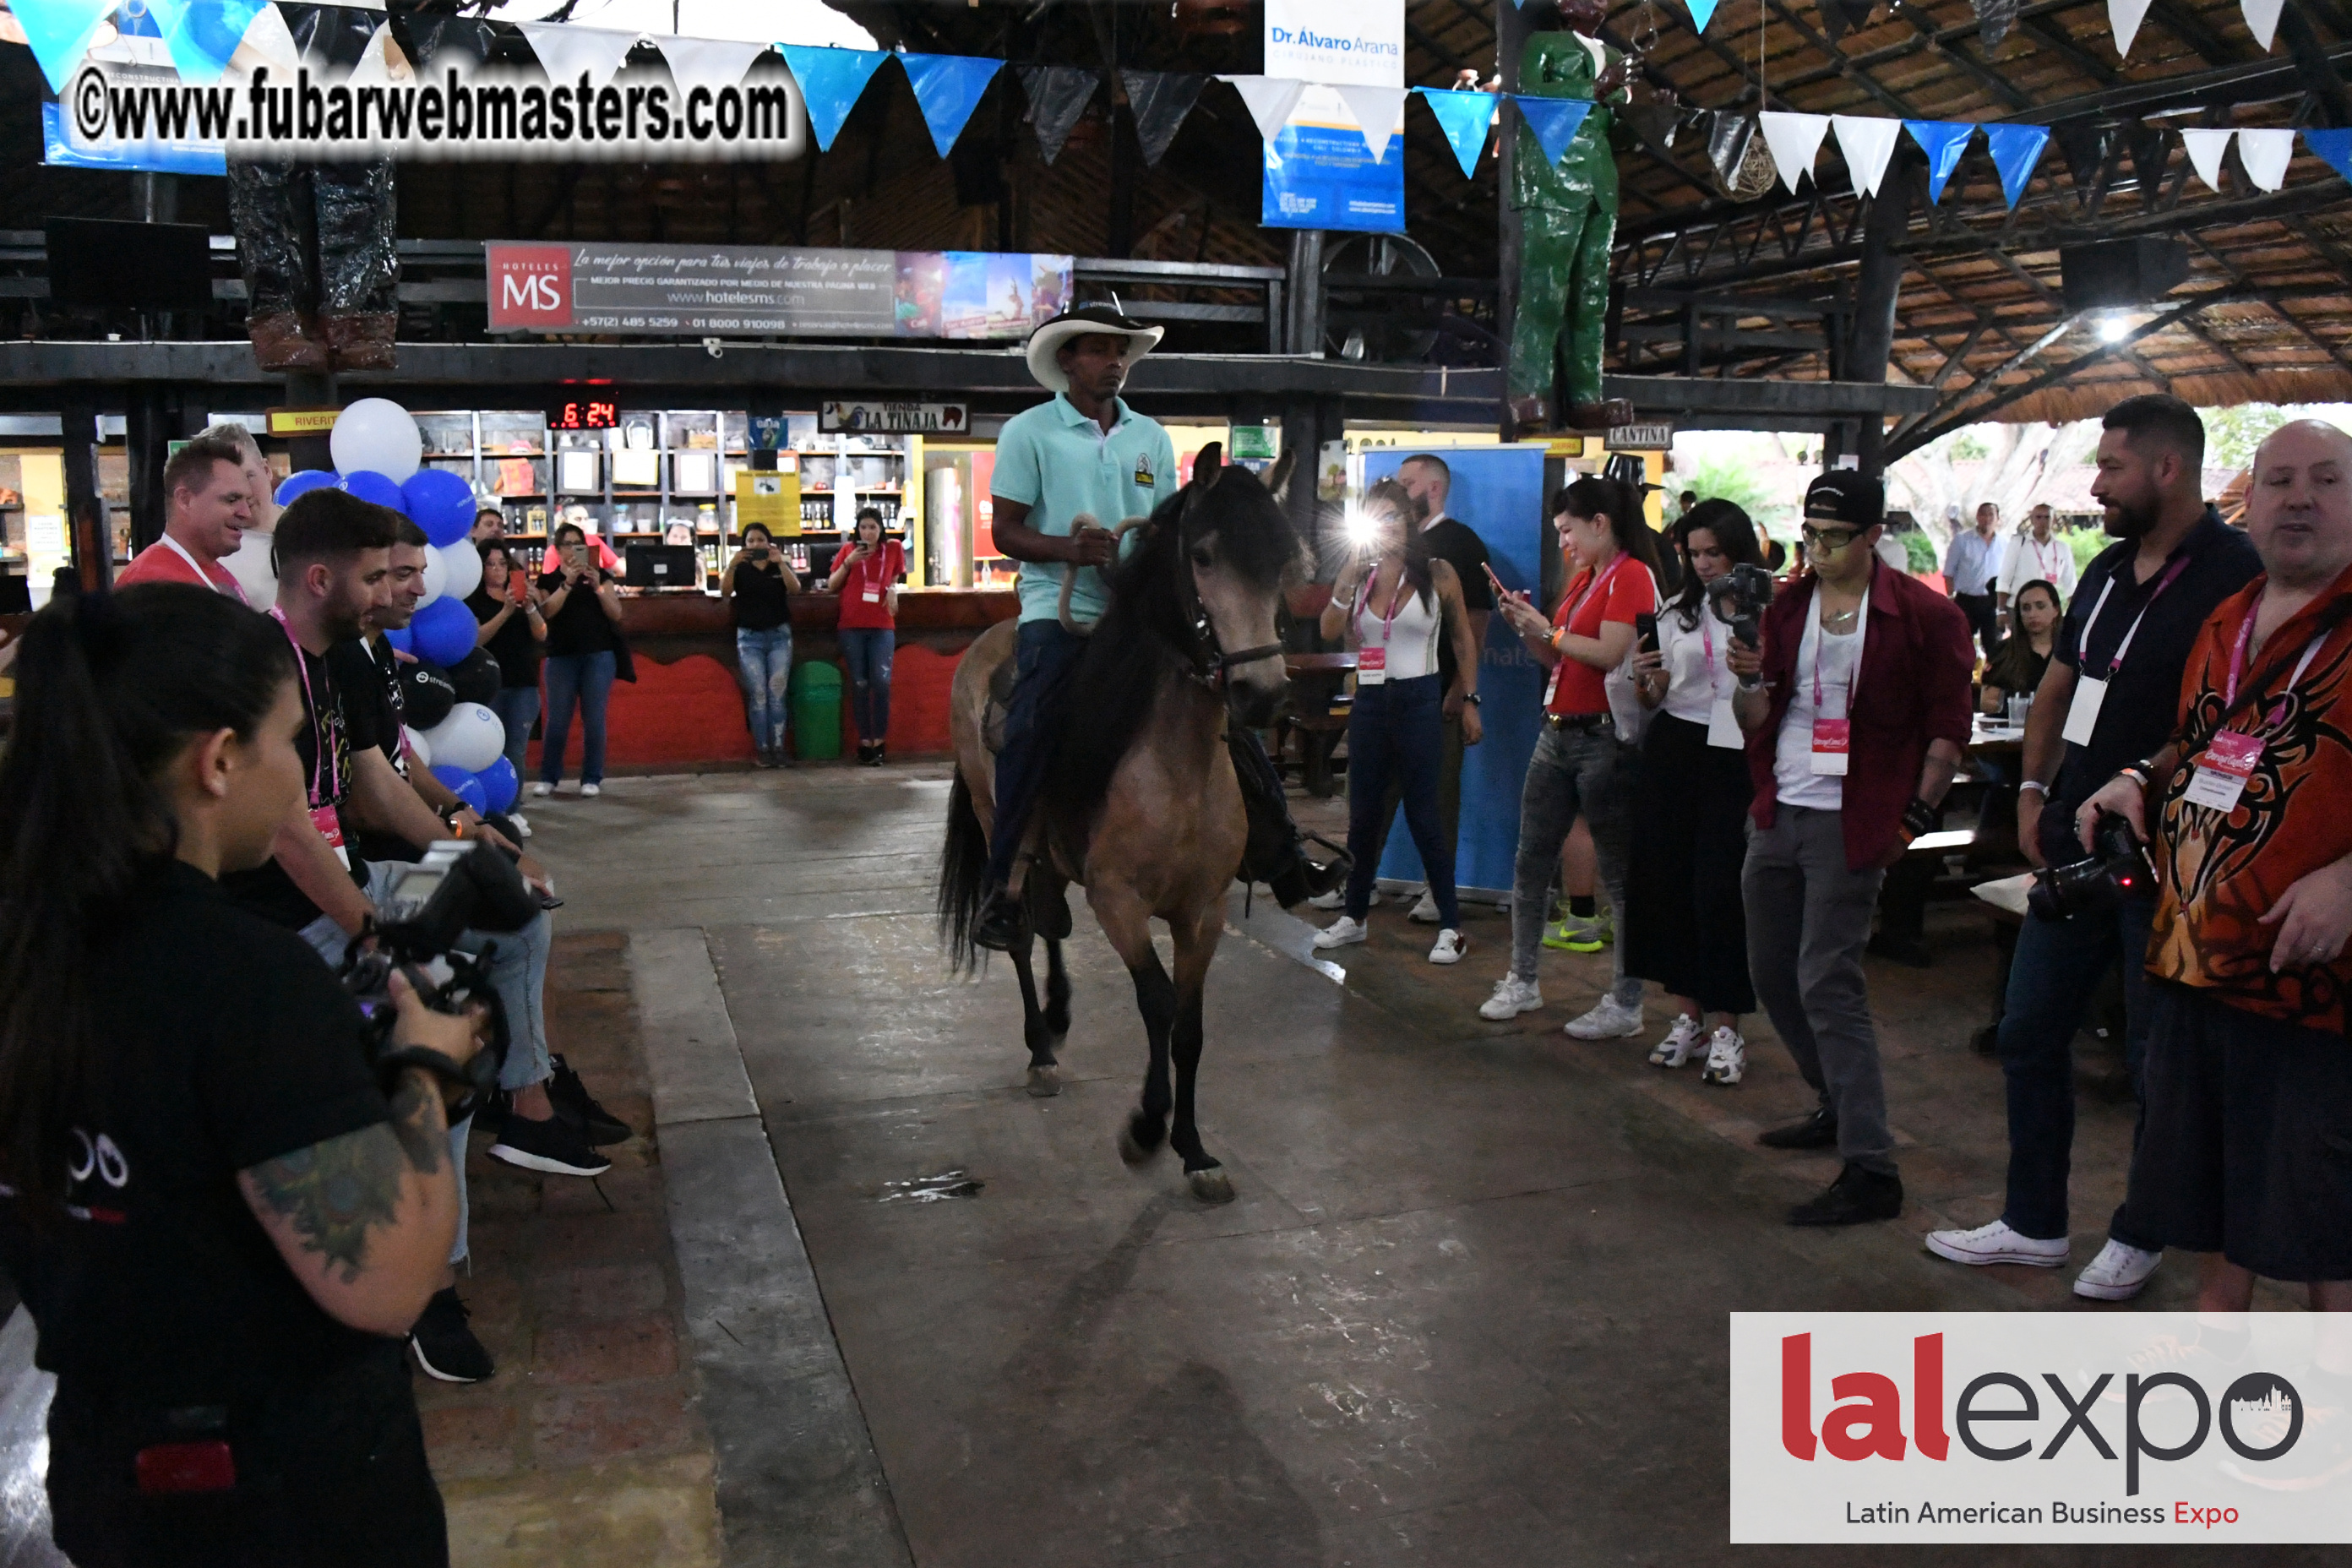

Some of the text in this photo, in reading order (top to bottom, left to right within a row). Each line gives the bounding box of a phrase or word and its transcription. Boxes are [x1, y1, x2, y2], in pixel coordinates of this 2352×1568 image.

[1272, 26, 1398, 56] Dr. Álvaro Arana
[1273, 50, 1334, 63] CIRUJANO
[503, 263, 558, 271] HOTELES
[574, 248, 892, 278] La mejor opción para tus viajes de trabajo o placer
[591, 276, 620, 285] MEJOR
[623, 277, 655, 286] PRECIO
[656, 278, 718, 287] GARANTIZADO
[720, 279, 739, 287] POR
[741, 280, 769, 288] MEDIO
[770, 280, 783, 289] DE
[784, 280, 823, 290] NUESTRA
[503, 274, 561, 311] MS
[667, 291, 805, 306] www.hotelesms.com
[582, 318, 619, 327] +57(2)
[622, 318, 645, 327] 485
[648, 318, 678, 328] 5259
[693, 318, 705, 328] 01
[709, 319, 740, 329] 8000
[743, 318, 786, 329] 910098
[564, 402, 614, 422] 6:24
[883, 403, 921, 411] TIENDA
[866, 411, 939, 430] LA TINAJA
[1609, 426, 1669, 444] CANTINA
